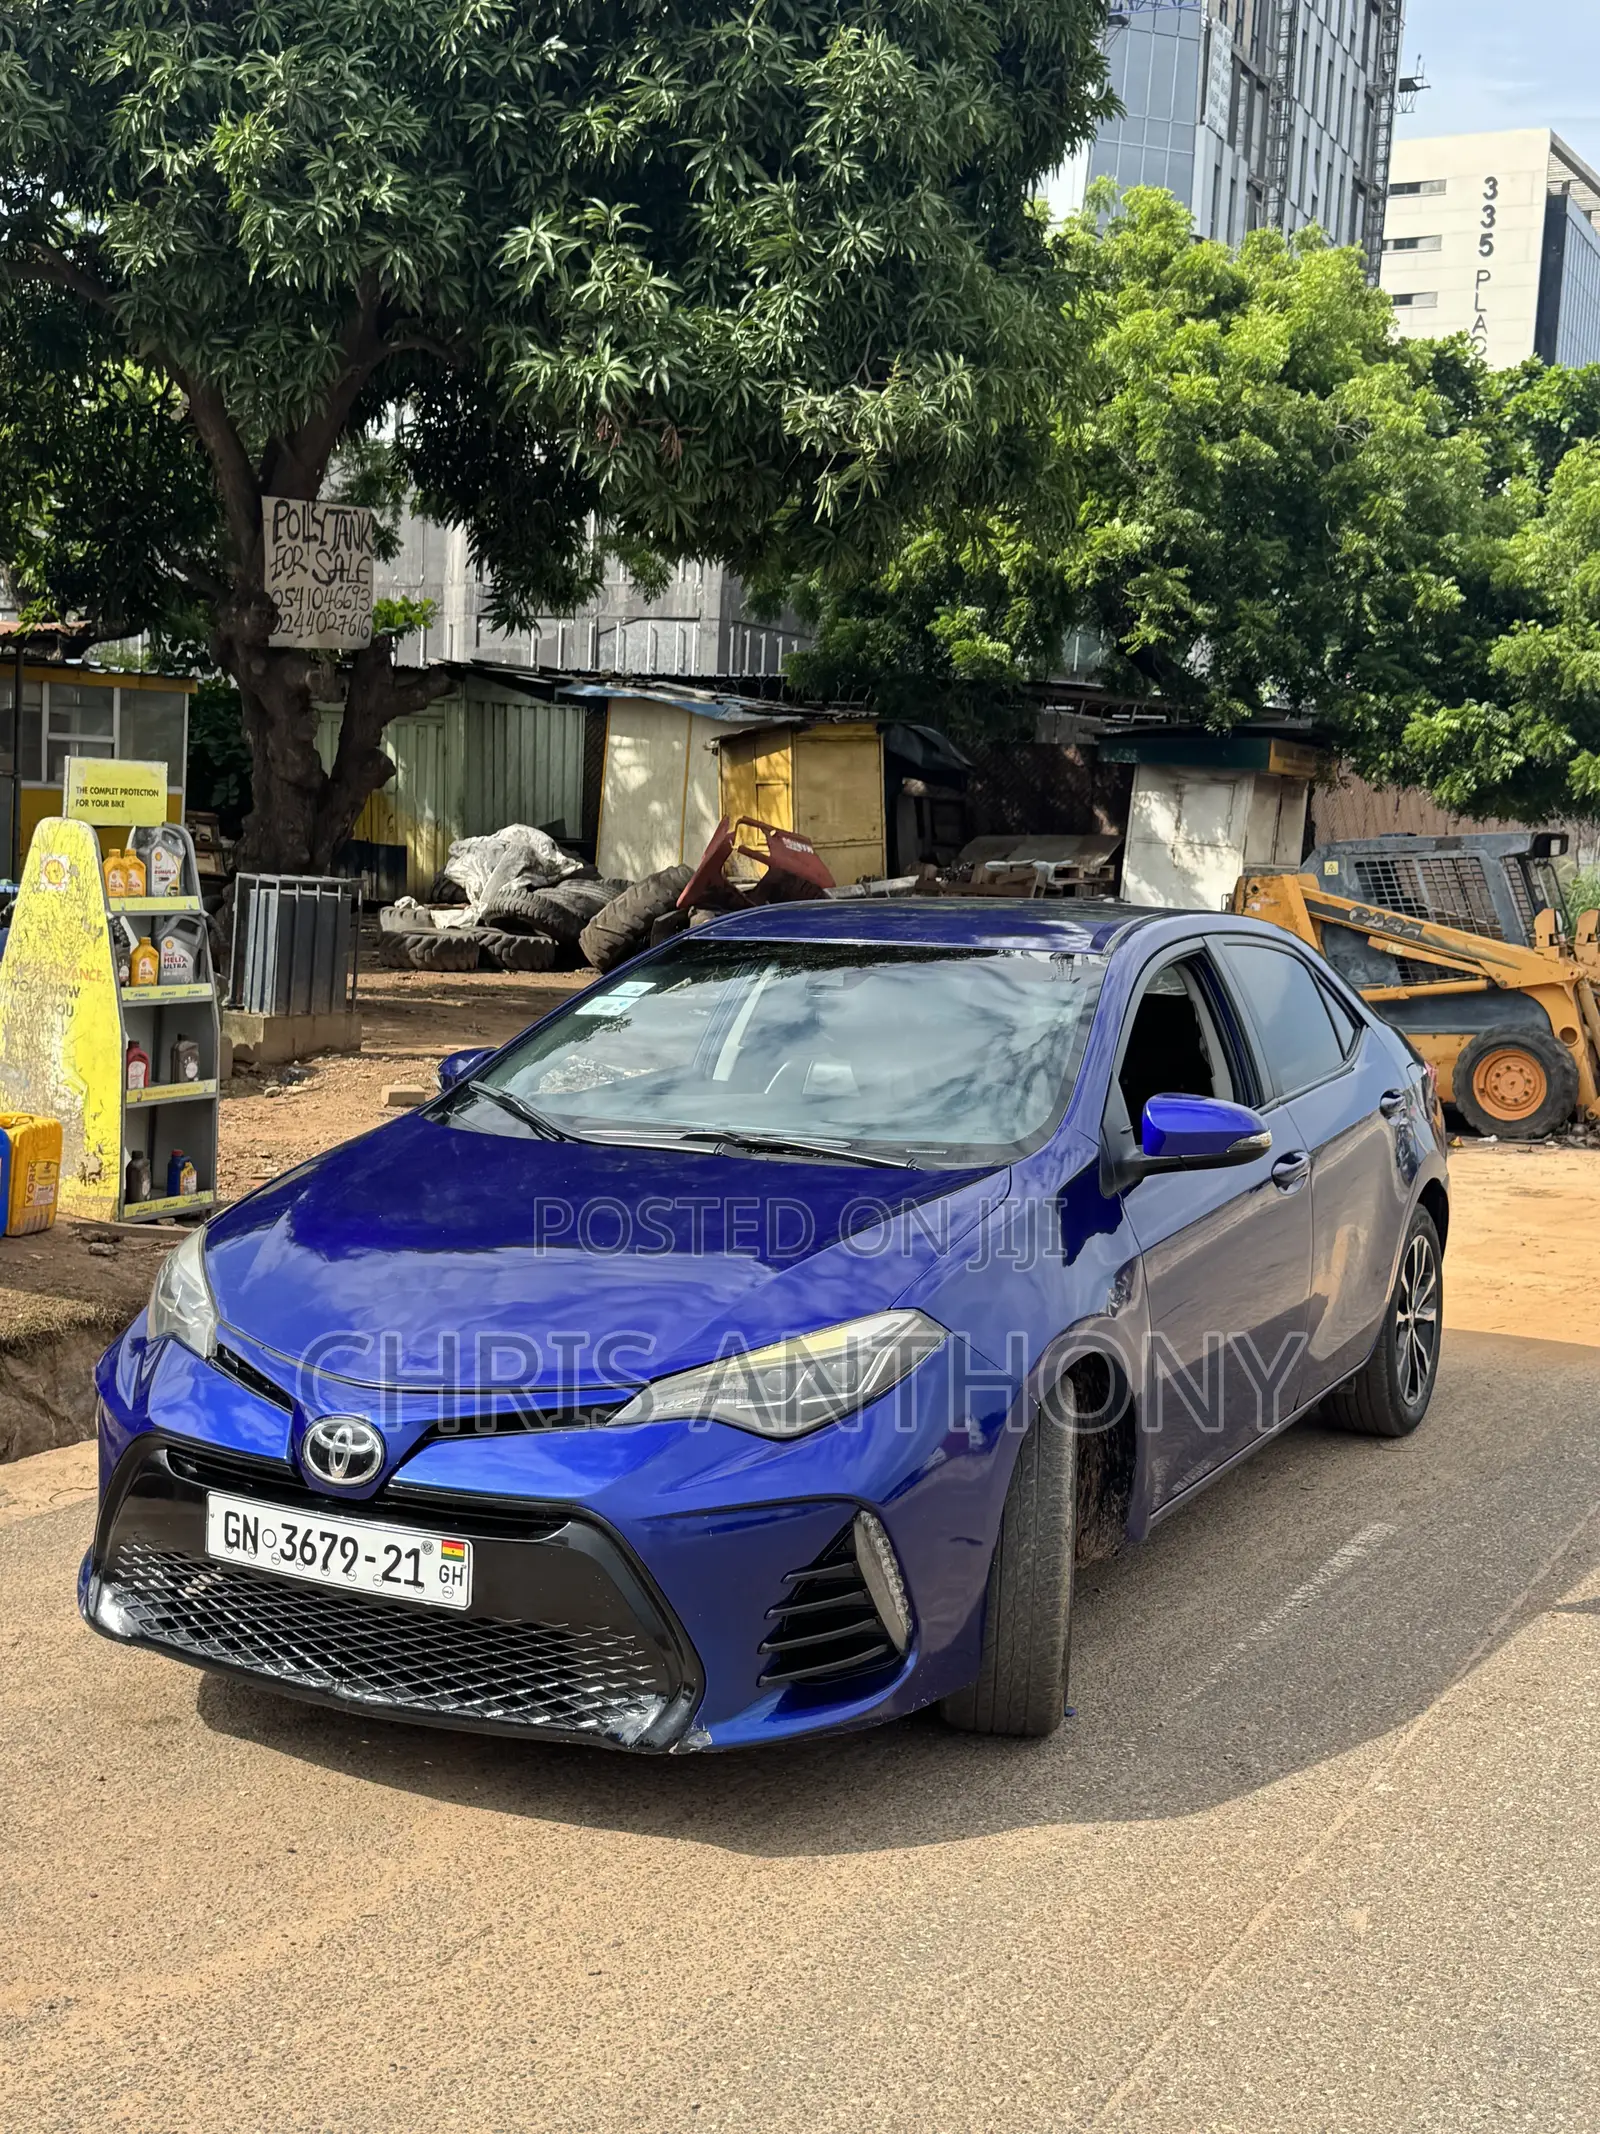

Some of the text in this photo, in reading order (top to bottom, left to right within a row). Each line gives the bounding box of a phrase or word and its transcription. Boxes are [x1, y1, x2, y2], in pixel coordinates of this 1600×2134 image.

[1471, 176, 1498, 357] 335 PLAC
[270, 544, 371, 586] FOR SALE
[76, 786, 159, 797] THE COMPLET PROTECTION
[76, 799, 125, 808] FOR YOUR BIKE
[224, 1511, 425, 1588] GN 3679-21
[439, 1564, 463, 1587] GH
